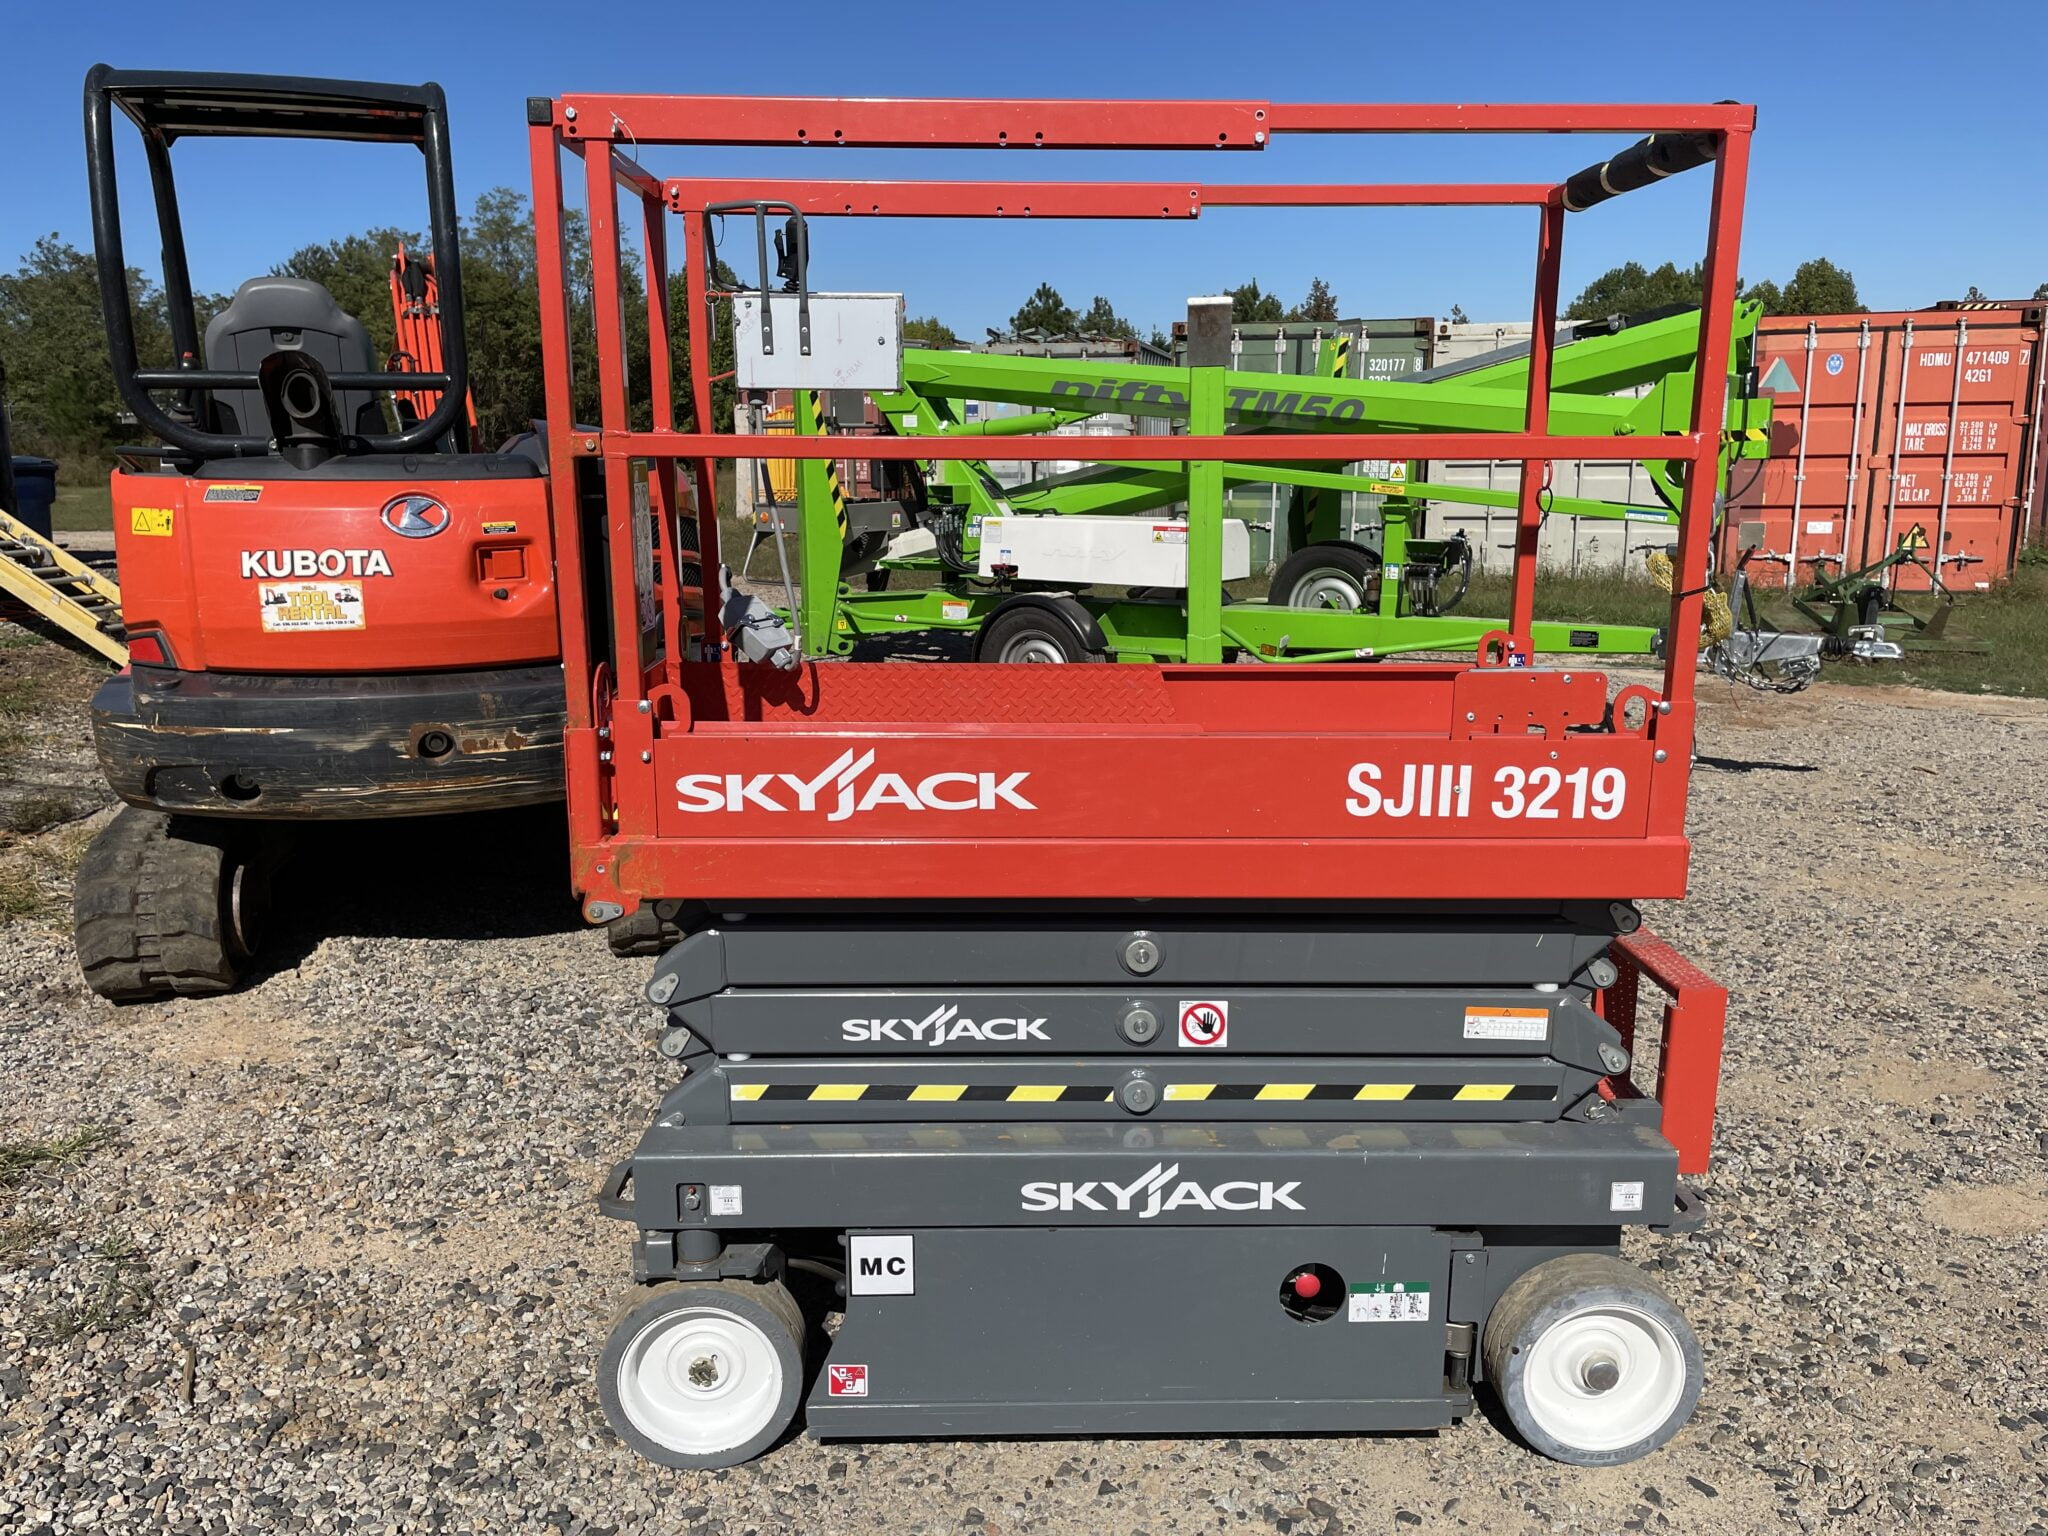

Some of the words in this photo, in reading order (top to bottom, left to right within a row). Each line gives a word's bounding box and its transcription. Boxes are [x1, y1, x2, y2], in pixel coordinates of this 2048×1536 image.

[1369, 358, 1406, 372] 320177
[1414, 358, 1422, 372] 8
[1919, 353, 1952, 366] HDMU
[1966, 351, 2010, 365] 471409
[2021, 350, 2029, 365] 7
[1965, 369, 1992, 383] 42G1
[1227, 388, 1365, 425] TM50
[1905, 423, 1922, 436] MAX
[1924, 423, 1947, 436] GROSS
[1904, 438, 1925, 451] TARE
[1900, 474, 1917, 488] NET
[1899, 488, 1932, 502] CU.CAP.
[241, 549, 394, 579] KUBOTA
[287, 591, 335, 607] TOOL
[277, 606, 348, 621] RENTAL
[676, 747, 1038, 822] SKYJACK
[1345, 763, 1473, 818] SJIII
[1491, 766, 1626, 820] 3219
[842, 1004, 1051, 1046] SKYJACK
[1020, 1162, 1306, 1219] SKYJACK
